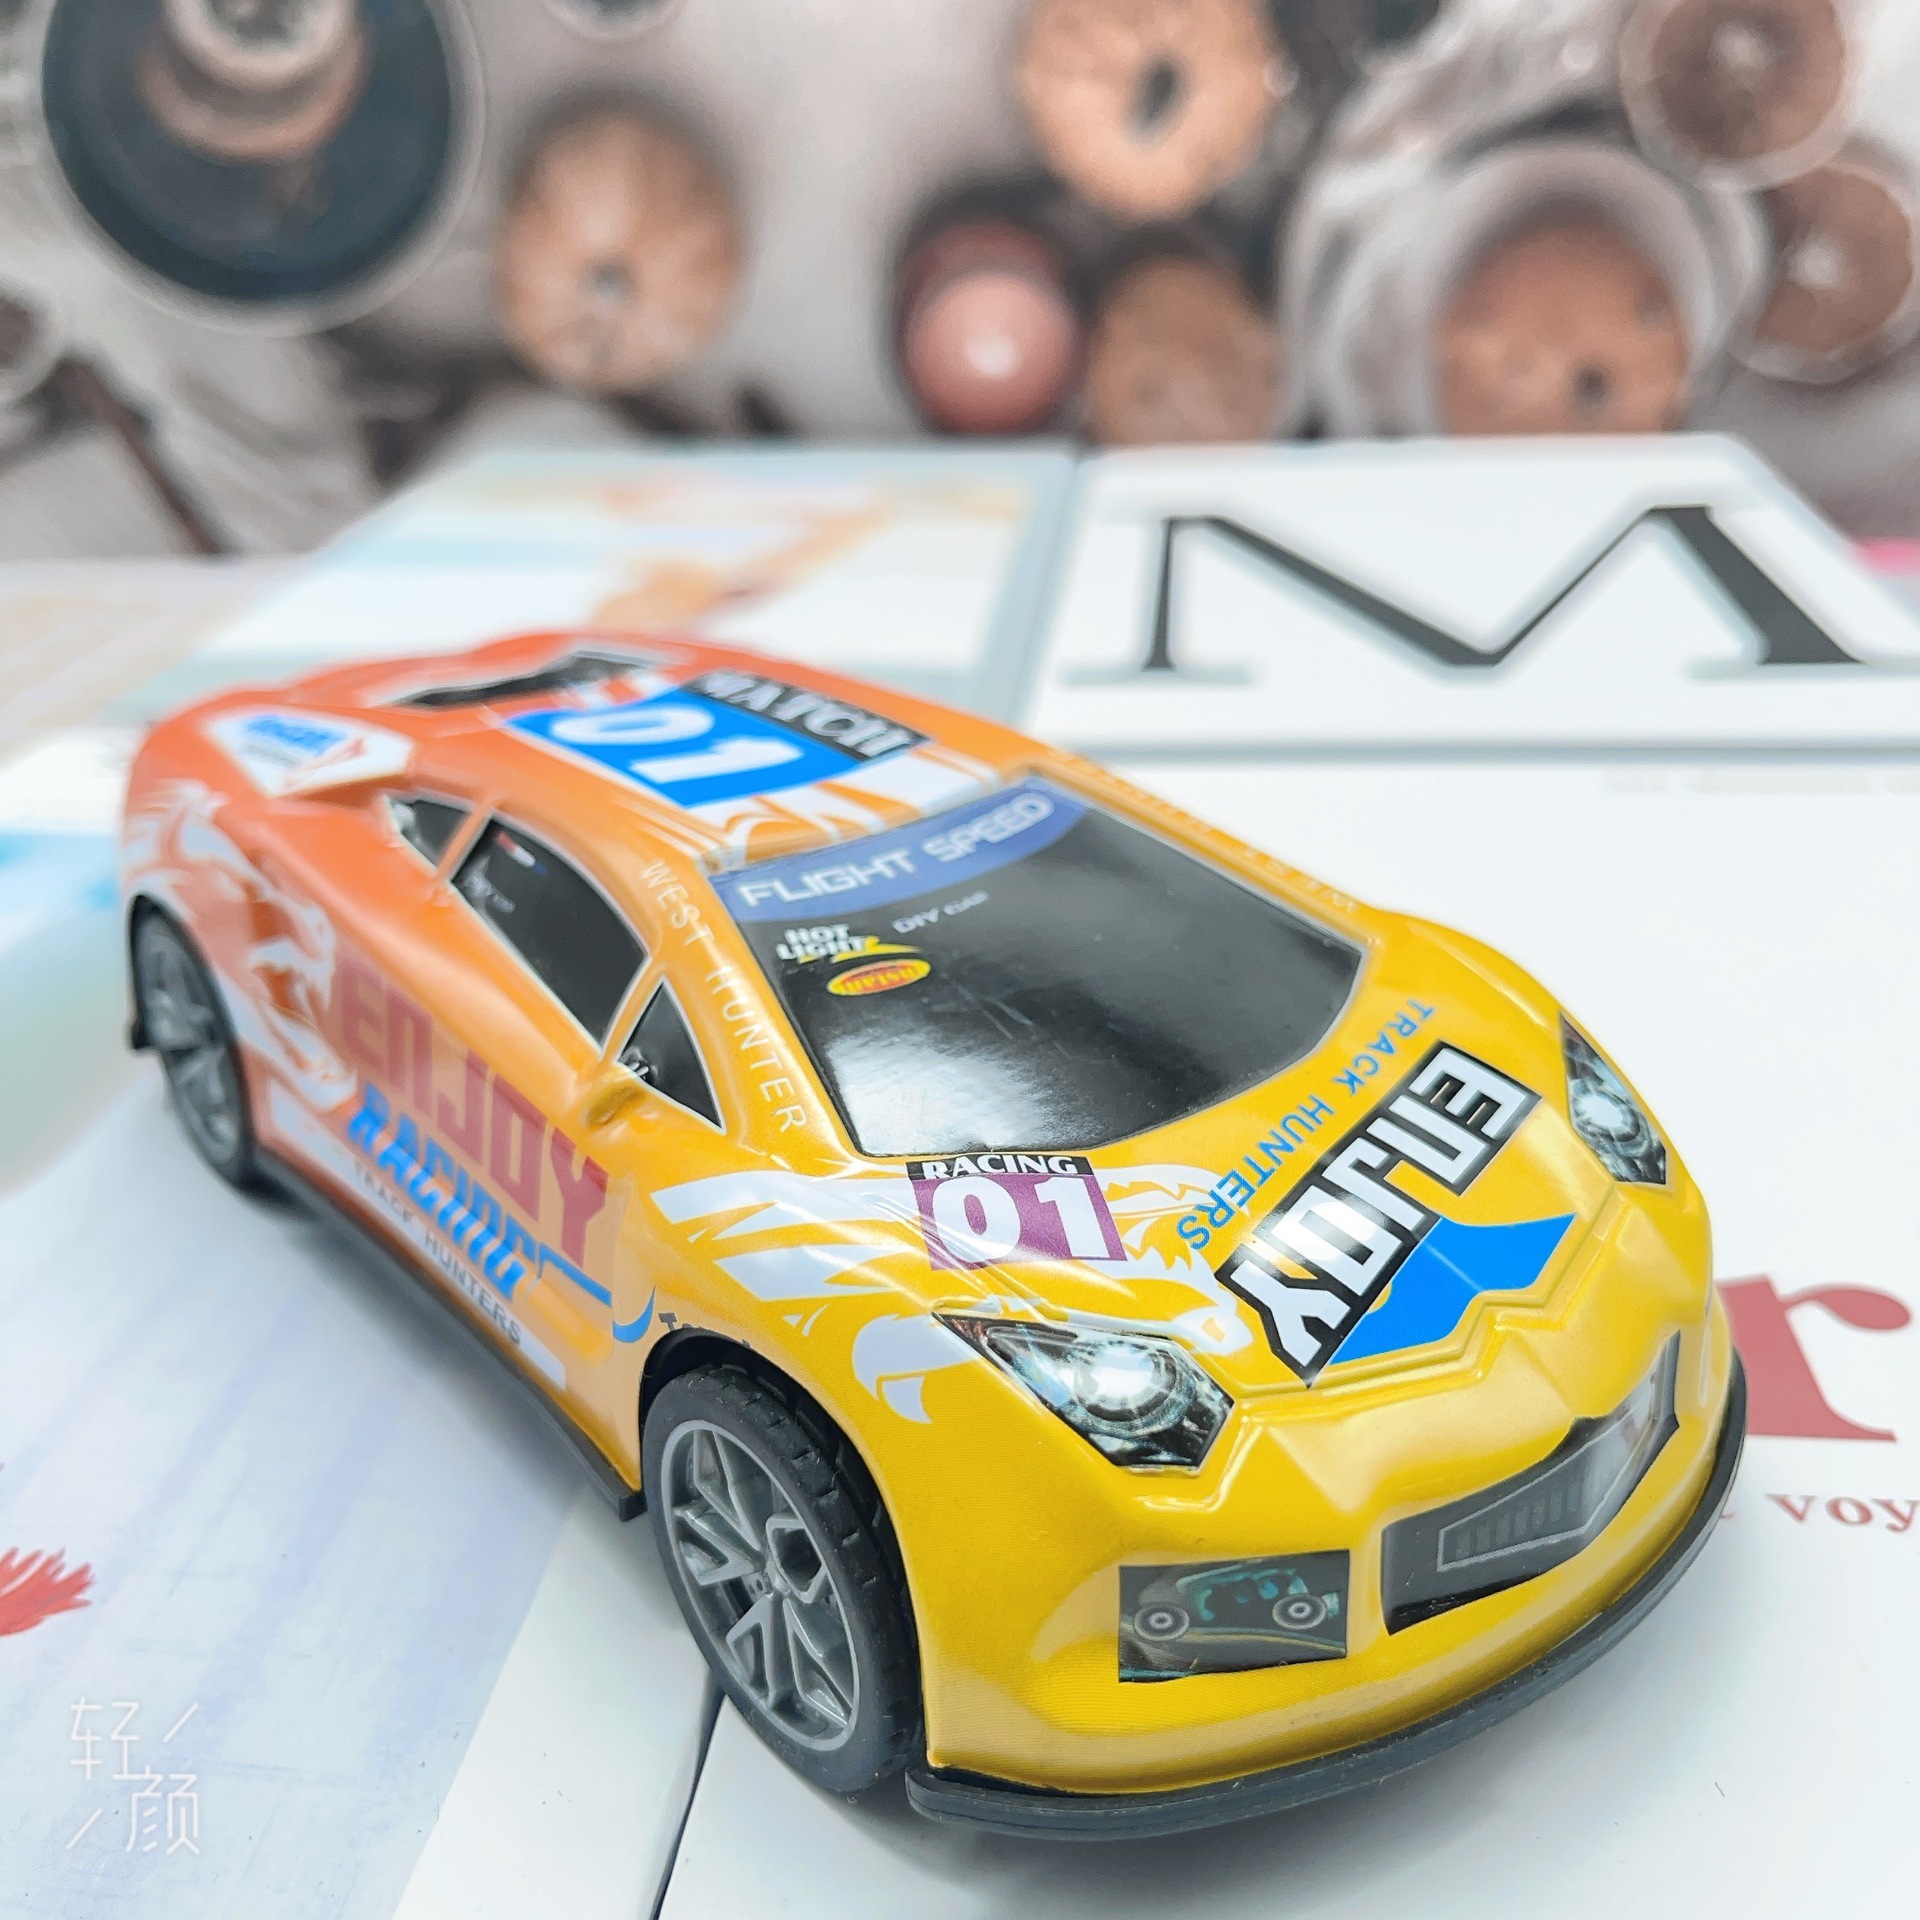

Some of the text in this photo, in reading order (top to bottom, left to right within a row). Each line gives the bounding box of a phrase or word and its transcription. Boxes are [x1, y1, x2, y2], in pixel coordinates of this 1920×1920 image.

[550, 706, 805, 785] 01
[704, 672, 911, 758] MATCH
[738, 793, 1054, 908] FLIGHT SPEED
[775, 935, 867, 961] LIGHT
[783, 923, 850, 946] HOT
[641, 860, 808, 1134] WEST HUNTER
[342, 955, 610, 1268] ENJOY
[922, 1153, 1078, 1181] RACING
[1175, 998, 1437, 1252] TRACK HUNTERS
[346, 1082, 540, 1304] RACING
[931, 1174, 1113, 1265] 01
[1228, 1045, 1532, 1370] ENJOY
[423, 1229, 523, 1346] HUNTERS
